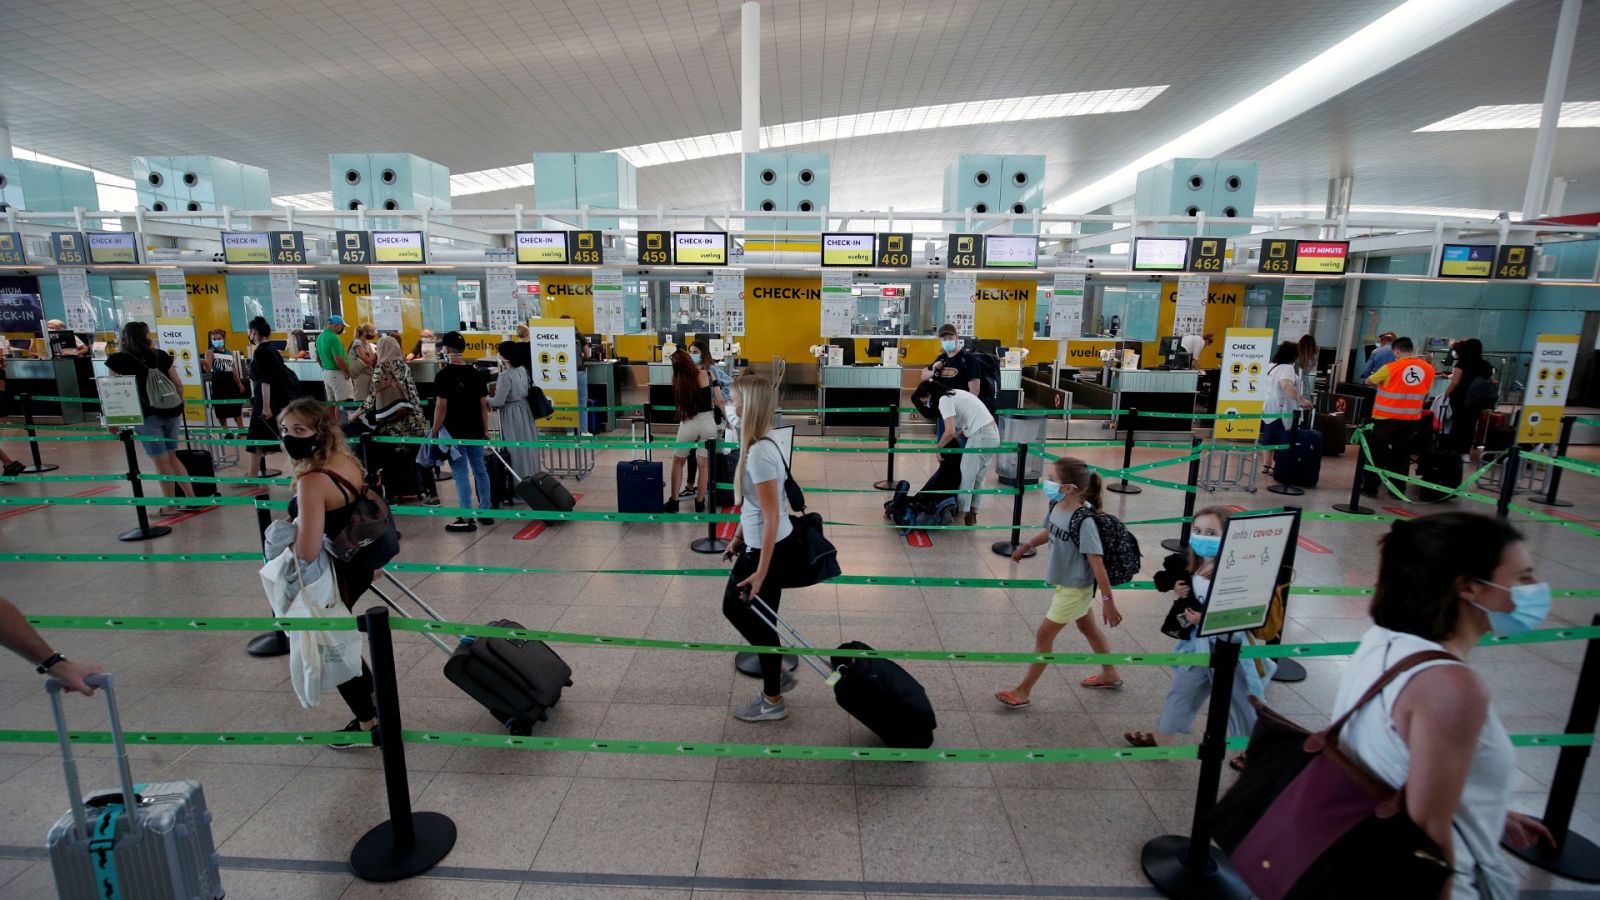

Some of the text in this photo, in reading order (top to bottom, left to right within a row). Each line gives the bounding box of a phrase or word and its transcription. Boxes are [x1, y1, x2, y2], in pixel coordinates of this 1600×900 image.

[92, 237, 122, 245] CHECK-IN
[60, 251, 81, 262] 455
[278, 251, 301, 262] 456
[343, 251, 365, 262] 457
[574, 251, 599, 262] 458
[642, 251, 667, 263] 459
[882, 253, 908, 265] 460
[952, 254, 977, 266] 461
[1194, 258, 1220, 270] 462
[1263, 260, 1289, 271] 463
[1319, 261, 1340, 269] vueling
[1500, 265, 1527, 277] 464
[186, 284, 219, 295] CK-IN
[547, 284, 593, 296] CHECK
[752, 287, 821, 300] CHECK-IN
[975, 288, 1029, 301] HECK-IN
[0, 311, 34, 320] CK-IN
[1232, 528, 1283, 540] info COVID-19
